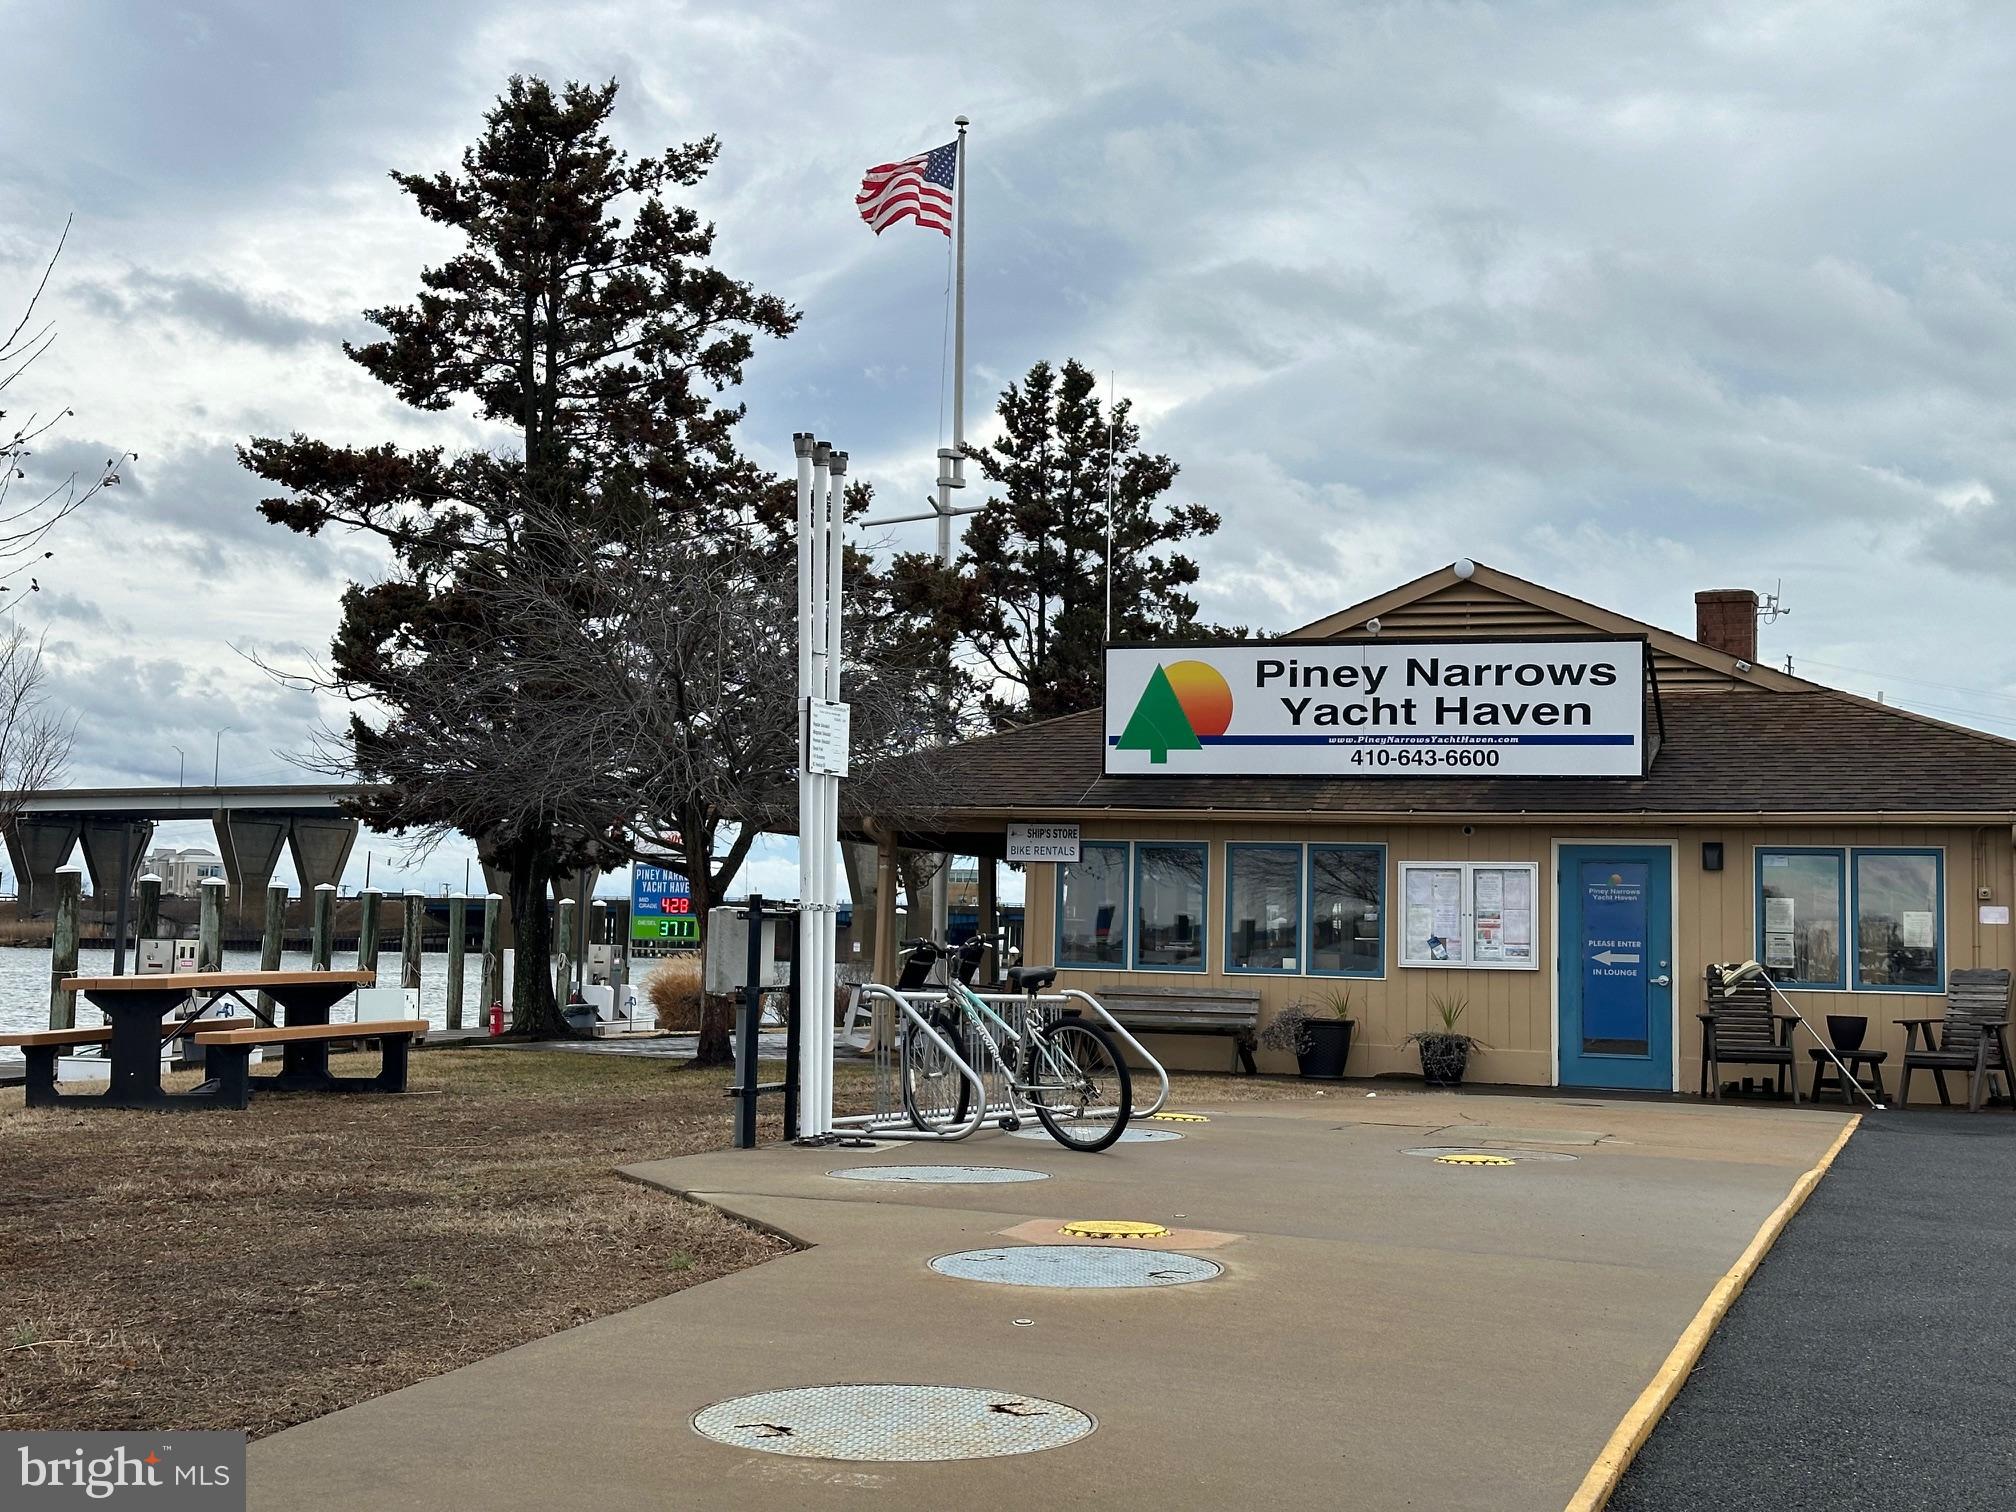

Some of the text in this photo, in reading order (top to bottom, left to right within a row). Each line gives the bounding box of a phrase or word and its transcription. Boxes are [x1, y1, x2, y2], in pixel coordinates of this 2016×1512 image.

[1256, 658, 1617, 695] Piney Narrows
[1280, 697, 1591, 726] Yacht Haven
[1328, 736, 1520, 745] www.PineyNarrowsYachtHaven.com
[1350, 749, 1500, 767] 410-643-6600
[1027, 828, 1078, 839] SHIP'S STORE
[1010, 845, 1075, 856] BIKE RENTALS
[636, 869, 660, 881] PINEY
[642, 881, 690, 893] YACHT HAVE
[661, 898, 689, 914] 428
[659, 921, 688, 936] 371
[1588, 940, 1641, 948] PLEASE ENTER
[1592, 968, 1638, 977] IN LOUNGE
[967, 1010, 1005, 1067] SCHWINN
